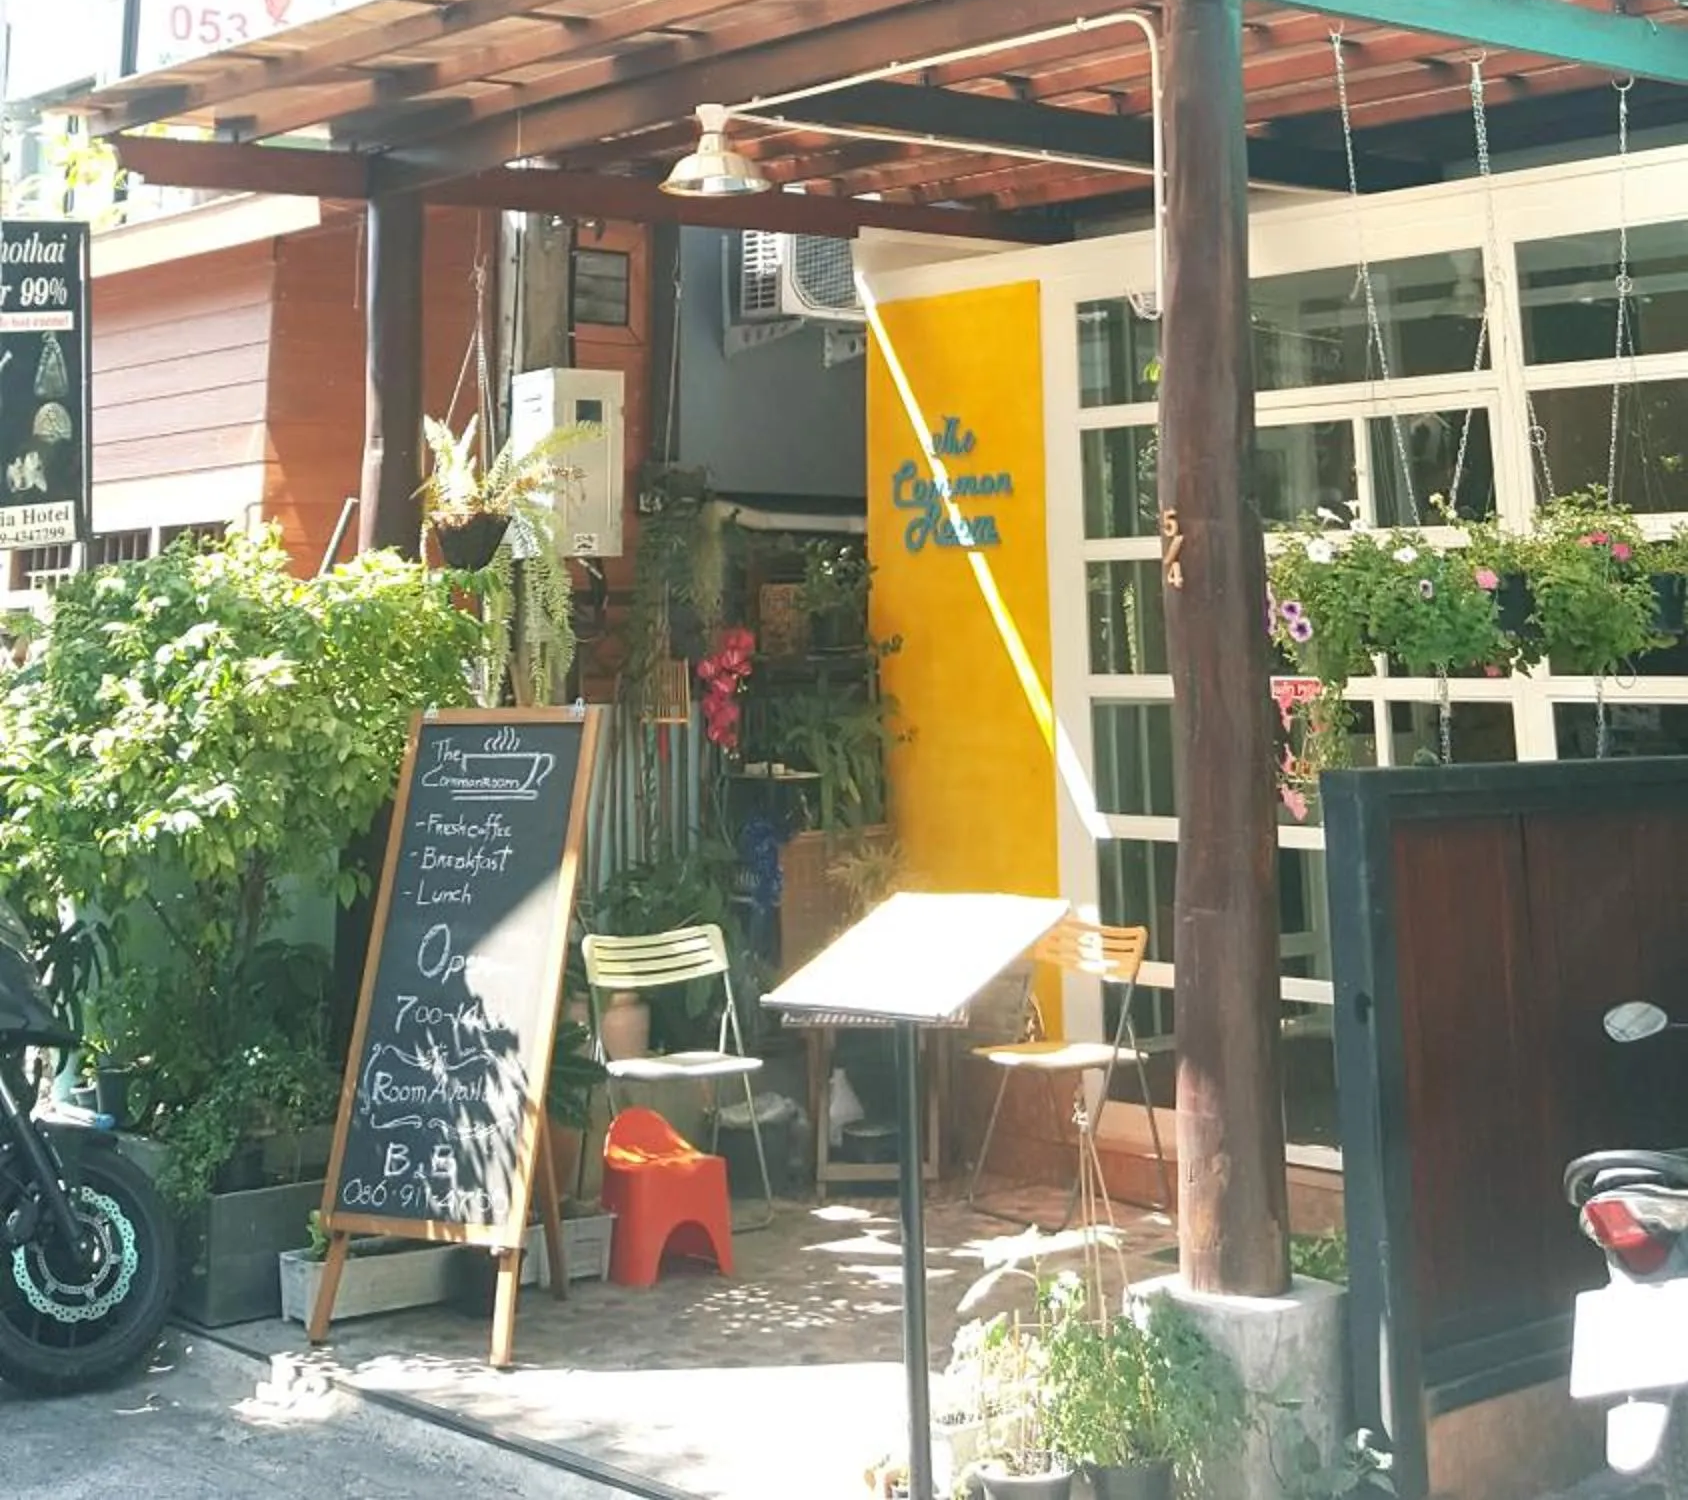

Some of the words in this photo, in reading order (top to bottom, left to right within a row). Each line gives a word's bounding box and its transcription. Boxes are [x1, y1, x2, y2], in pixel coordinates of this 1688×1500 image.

[20, 277, 68, 307] 99%
[22, 504, 69, 525] Hotel
[431, 737, 462, 762] The
[372, 1070, 427, 1105] Room
